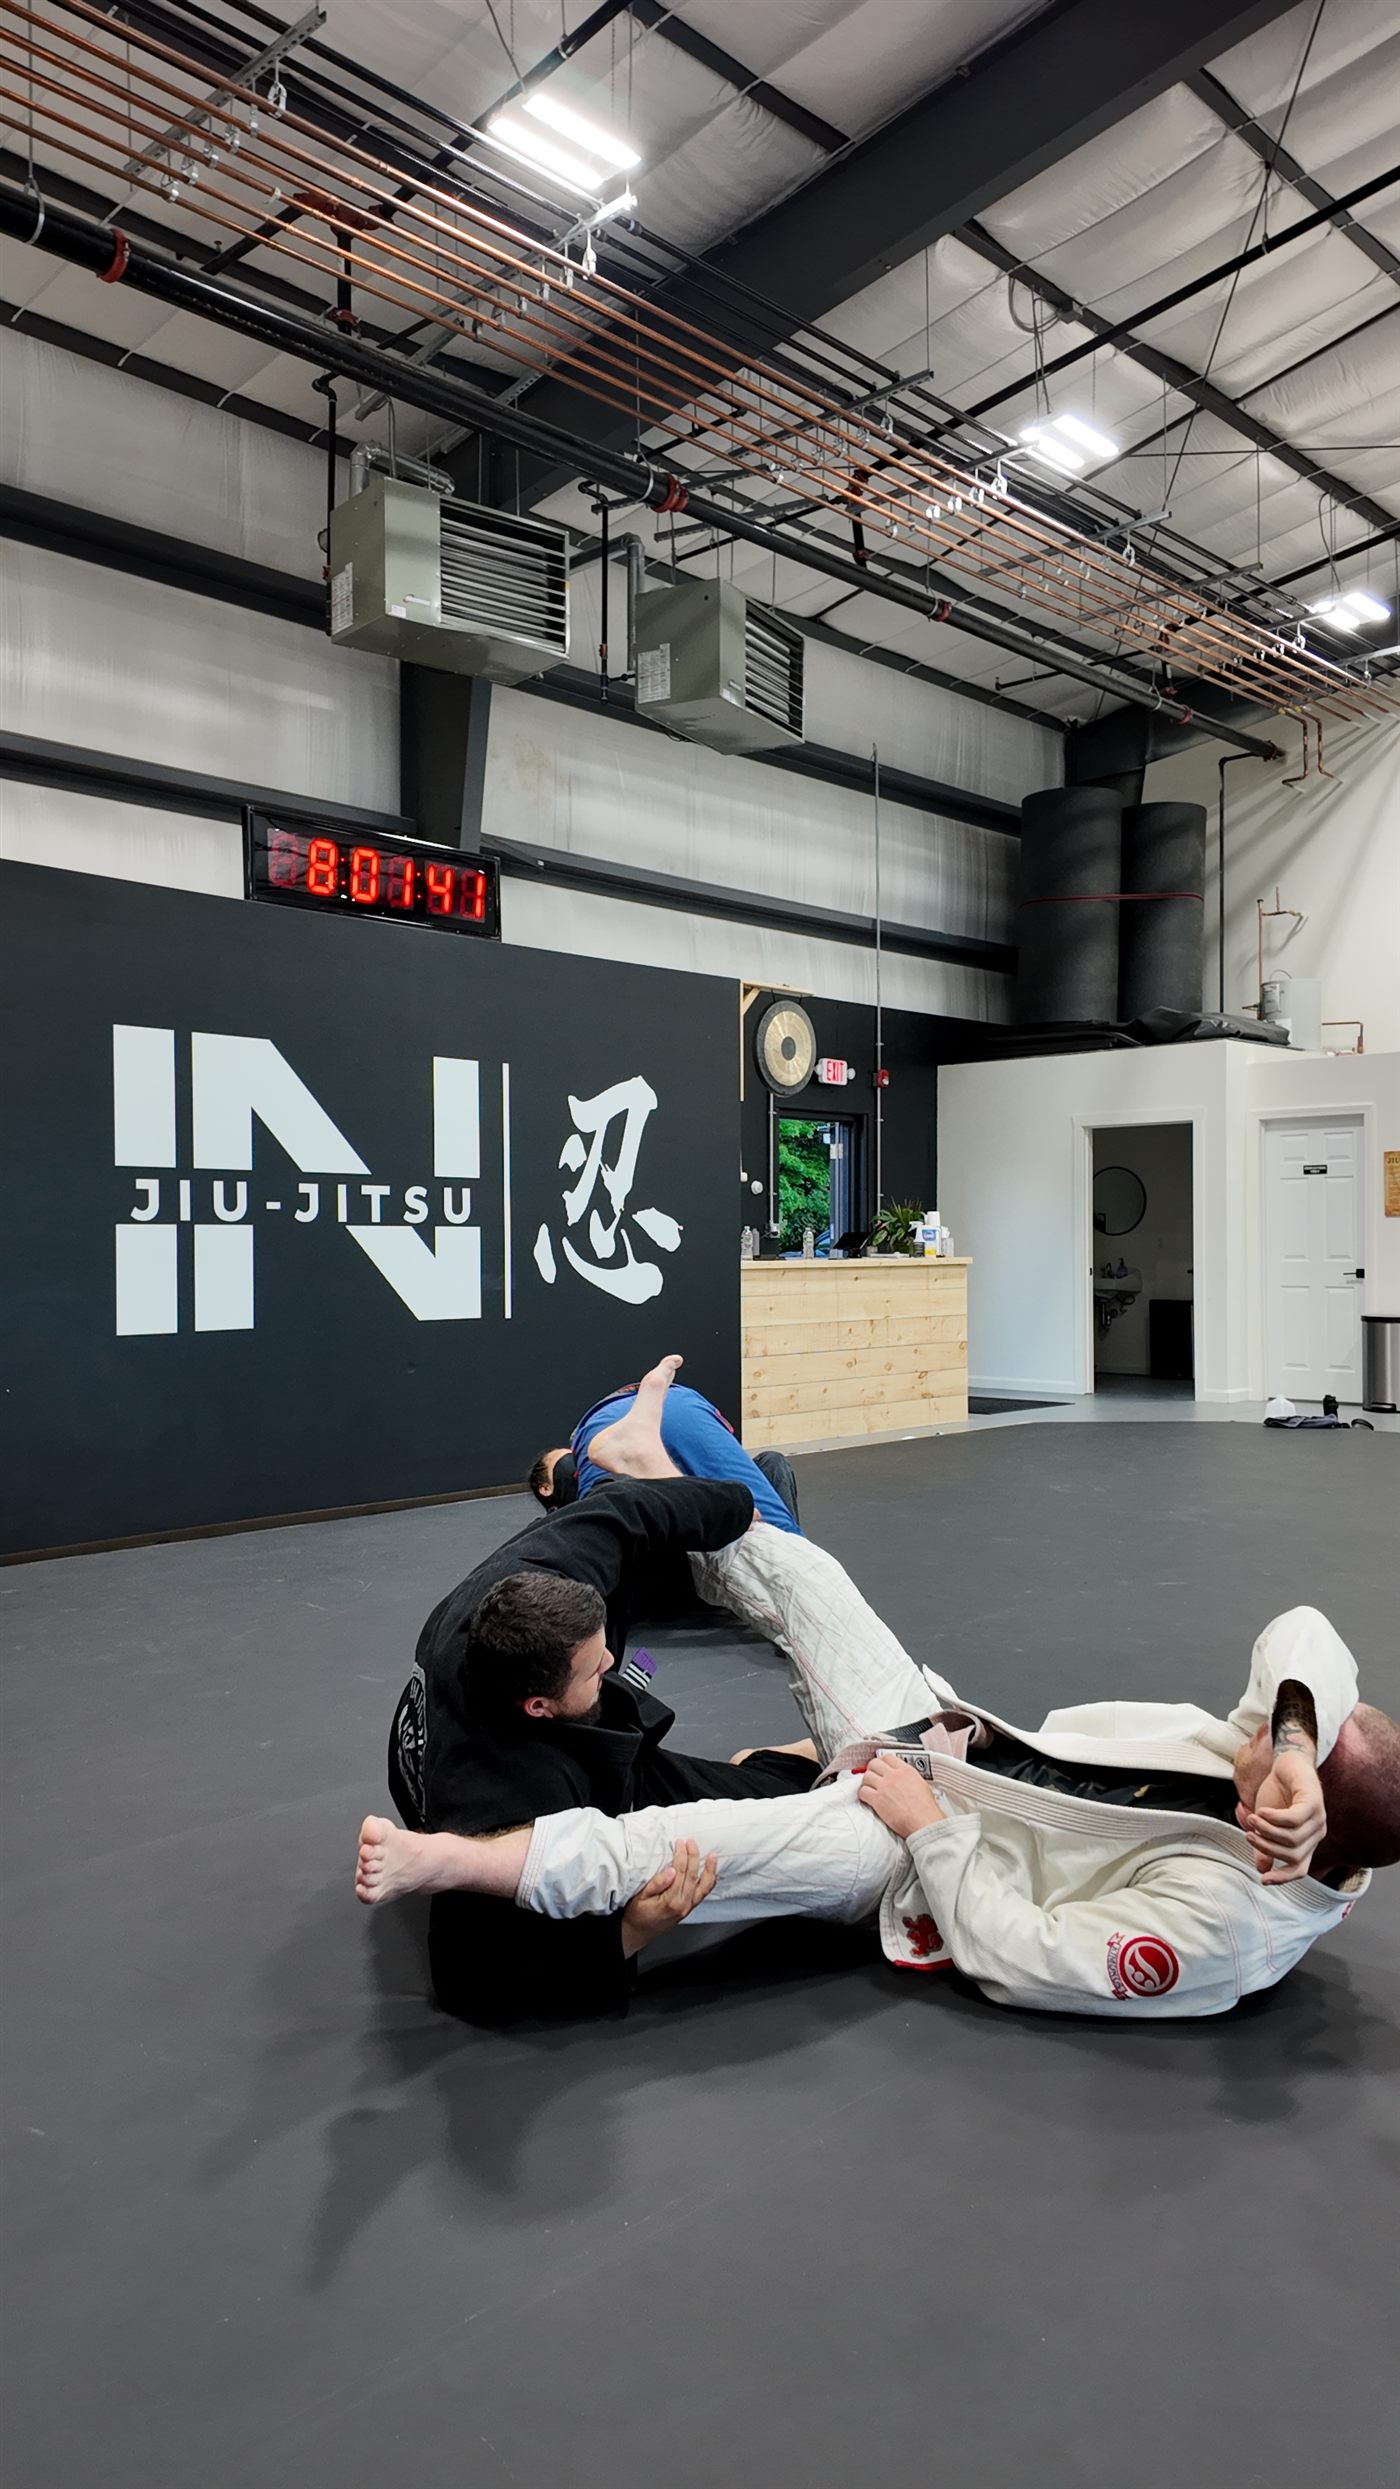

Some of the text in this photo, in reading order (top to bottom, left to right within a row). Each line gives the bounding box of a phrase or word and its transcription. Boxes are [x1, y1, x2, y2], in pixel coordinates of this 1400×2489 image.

[306, 838, 486, 919] 8:01:41
[826, 1060, 844, 1083] EXIT
[130, 1178, 472, 1225] JIU-JITSU
[533, 1074, 685, 1305] 忍
